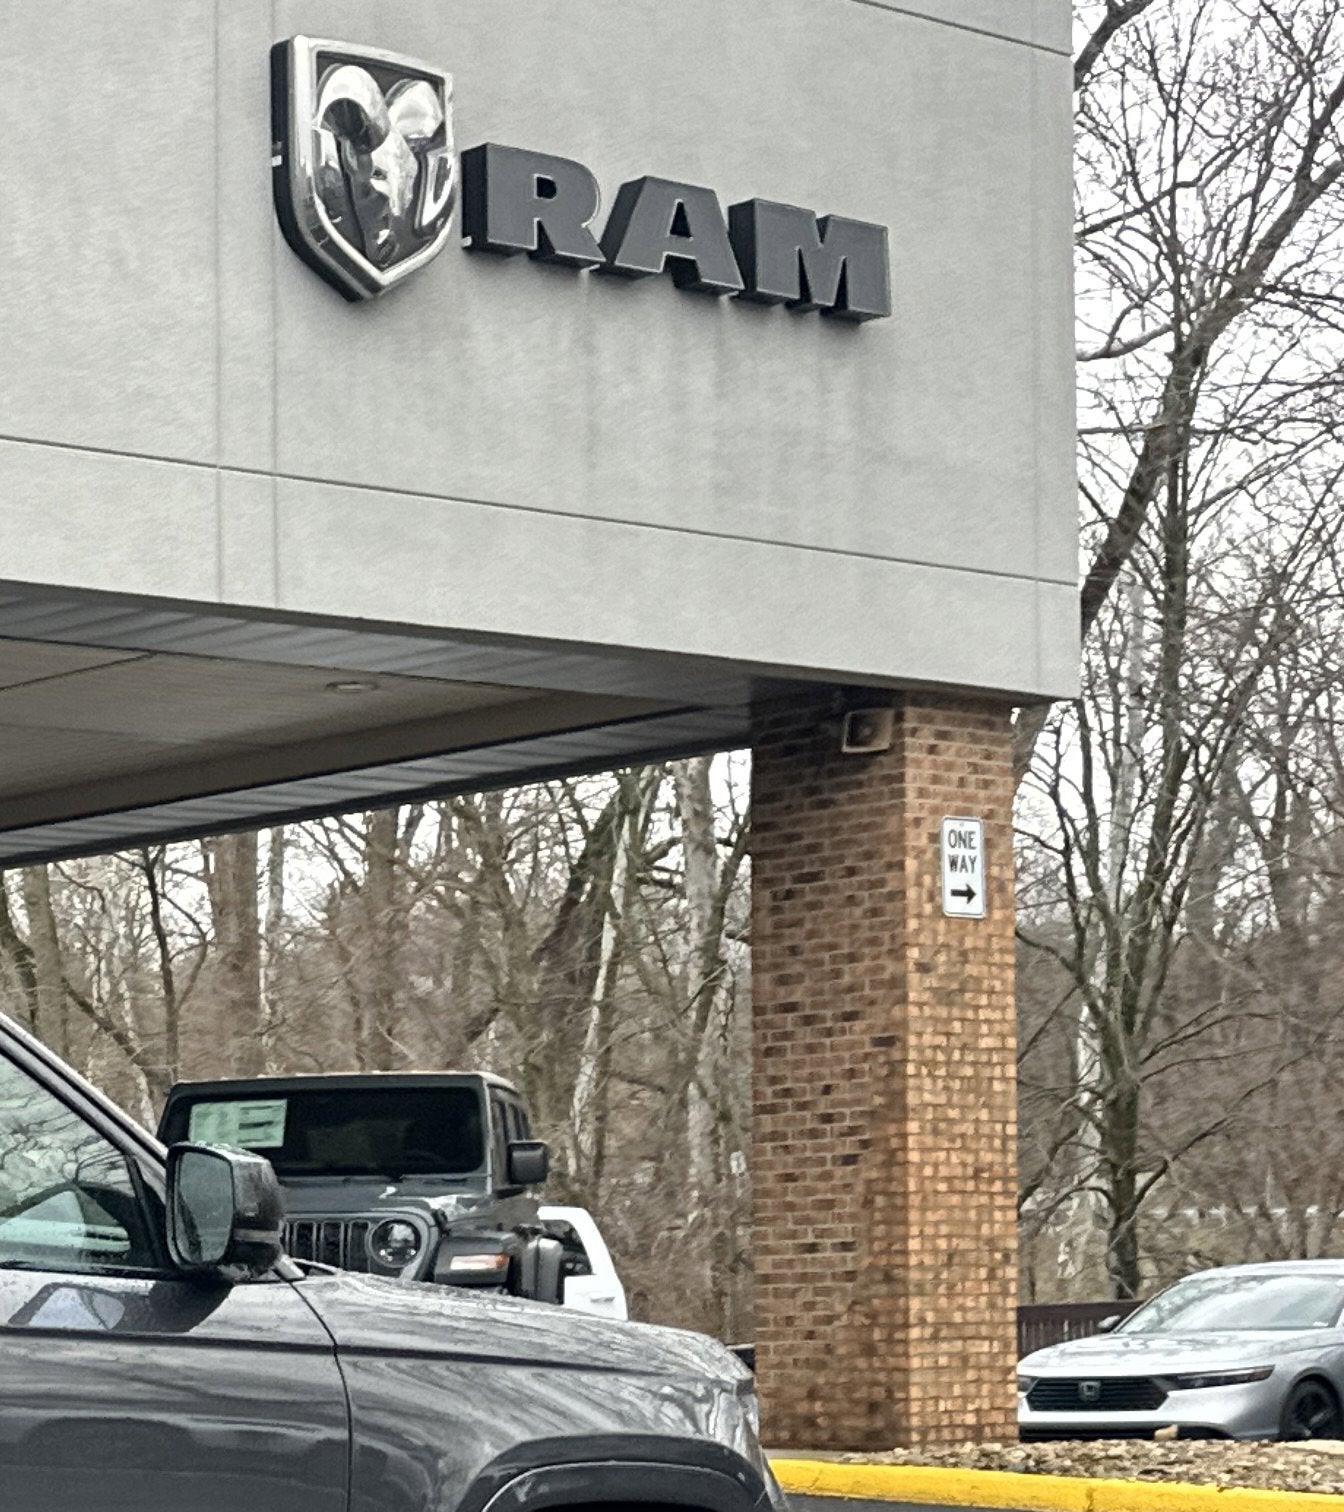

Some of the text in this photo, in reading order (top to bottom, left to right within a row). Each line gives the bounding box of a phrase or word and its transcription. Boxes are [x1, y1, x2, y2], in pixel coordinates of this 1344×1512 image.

[462, 142, 891, 322] RAM
[948, 829, 976, 850] ONE
[948, 854, 978, 874] WAY
